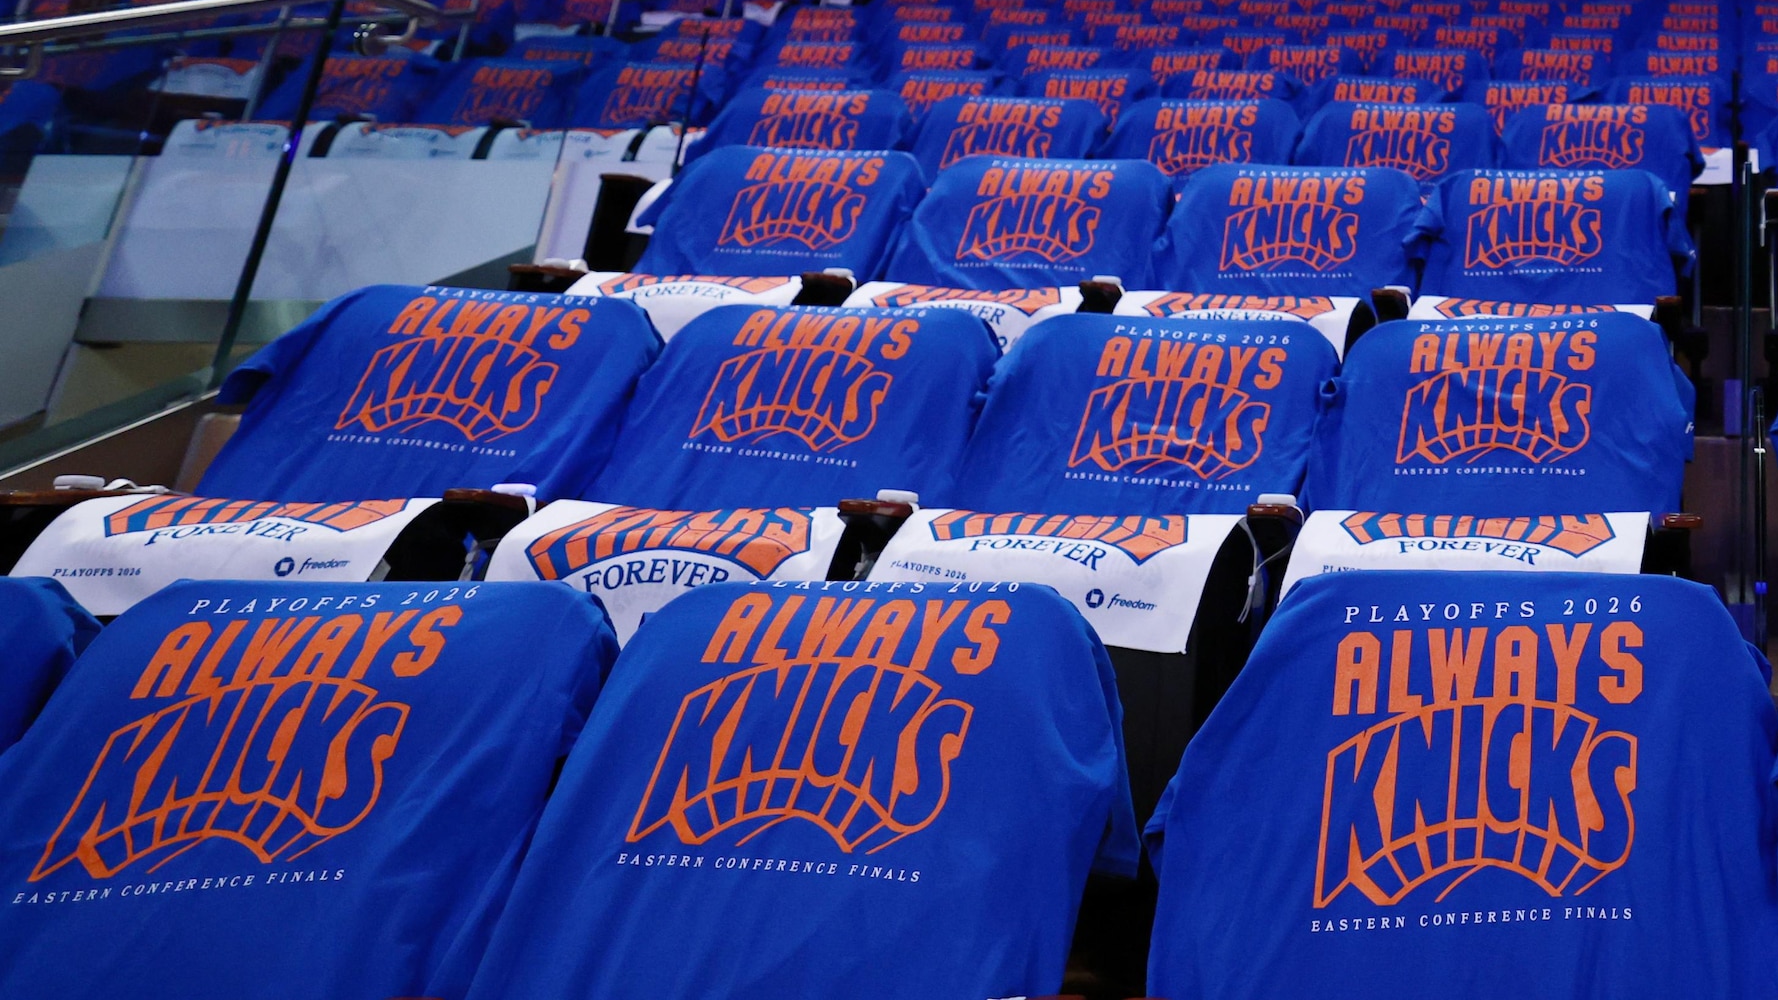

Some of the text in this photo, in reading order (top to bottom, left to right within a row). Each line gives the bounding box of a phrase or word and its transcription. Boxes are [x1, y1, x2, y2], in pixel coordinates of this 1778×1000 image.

[902, 79, 984, 100] ALWAYS
[1046, 78, 1127, 98] ALWAYS
[1193, 70, 1274, 92] ALWAYS
[1335, 83, 1417, 102] ALWAYS
[1486, 85, 1566, 105] ALWAYS
[1629, 85, 1710, 105] ALWAYS
[761, 94, 867, 115] ALWAYS
[958, 103, 1061, 128] ALWAYS
[1155, 106, 1257, 129] ALWAYS
[1546, 104, 1647, 124] ALWAYS
[1350, 110, 1454, 132] ALWAYS
[1148, 122, 1253, 175] KNICKS
[1344, 125, 1450, 181] KNICKS
[1539, 119, 1644, 168] KNICKS
[745, 153, 884, 187] ALWAYS
[977, 168, 1113, 198] ALWAYS
[1229, 177, 1365, 206] ALWAYS
[1470, 176, 1603, 205] ALWAYS
[718, 179, 866, 250] KNICKS
[956, 192, 1100, 262] KNICKS
[1219, 201, 1358, 271] KNICKS
[1464, 200, 1602, 269] KNICKS
[424, 287, 538, 303] PLAYOFFS
[388, 296, 590, 349] ALWAYS
[733, 310, 919, 360] ALWAYS
[1115, 325, 1290, 345] PLAYOFFS 2026
[1420, 319, 1598, 332] PLAYOFFS 2026
[1096, 336, 1287, 389] ALWAYS
[1410, 330, 1597, 373] ALWAYS
[334, 334, 559, 443] KNICKS
[689, 346, 893, 453] KNICKS
[1067, 377, 1271, 479] KNICKS
[1395, 367, 1591, 464] KNICKS
[144, 517, 308, 546] FOREVER
[299, 557, 350, 572] freedom
[970, 537, 1107, 571] FOREVER
[1398, 539, 1541, 566] FOREVER
[53, 566, 141, 577] PLAYOFFS 2026
[583, 559, 729, 592] FOREVER
[945, 569, 967, 580] 2026
[189, 586, 480, 614] PLAYOFFS 2026
[1108, 592, 1157, 611] freedom
[1344, 595, 1643, 624] PLAYOFFS 2026
[701, 592, 1012, 675] ALWAYS
[130, 605, 463, 699] ALWAYS
[1332, 621, 1643, 716] ALWAYS
[626, 660, 973, 855] KNICKS
[28, 677, 409, 882] KNICKS
[1312, 698, 1637, 908] KNICKS
[617, 852, 921, 884] EASTERN CONFERENCE FINALS
[13, 868, 347, 904] EASTERN CONFERENCE FINALS
[1311, 906, 1633, 933] EASTERN CONFERENCE FINALS
